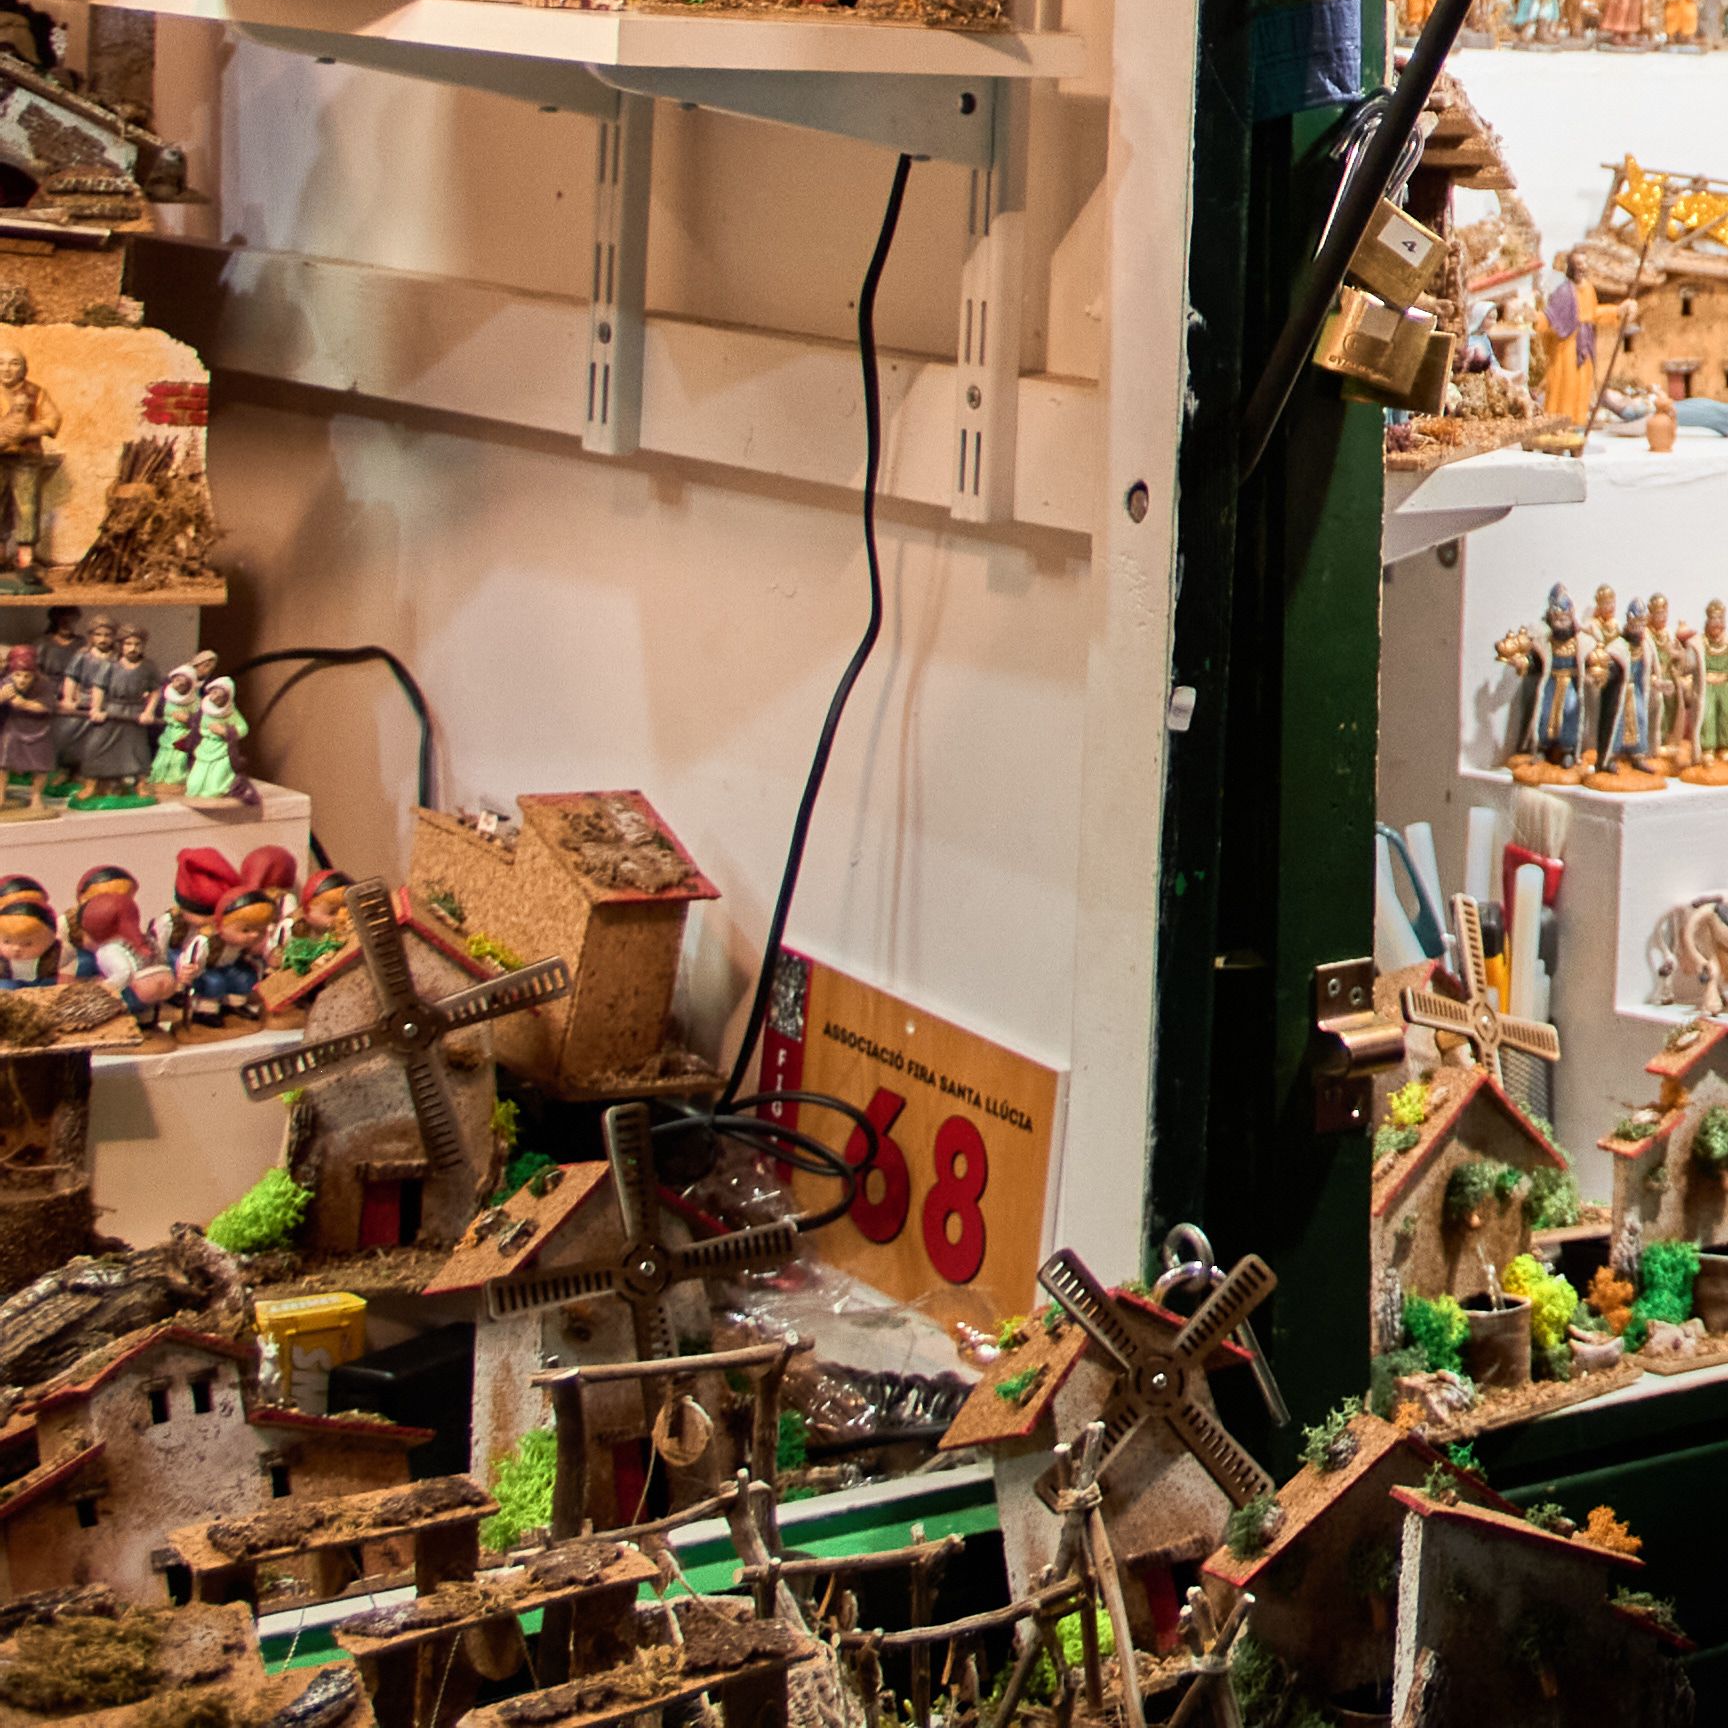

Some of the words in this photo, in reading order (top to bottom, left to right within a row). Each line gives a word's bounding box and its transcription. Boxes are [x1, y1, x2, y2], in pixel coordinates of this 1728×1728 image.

[823, 1021, 904, 1071] ASSOCIACIÓ
[907, 1060, 936, 1087] FIRA
[940, 1074, 981, 1109] SANTA
[985, 1096, 1033, 1132] LLÚCIA
[843, 1086, 988, 1285] 68
